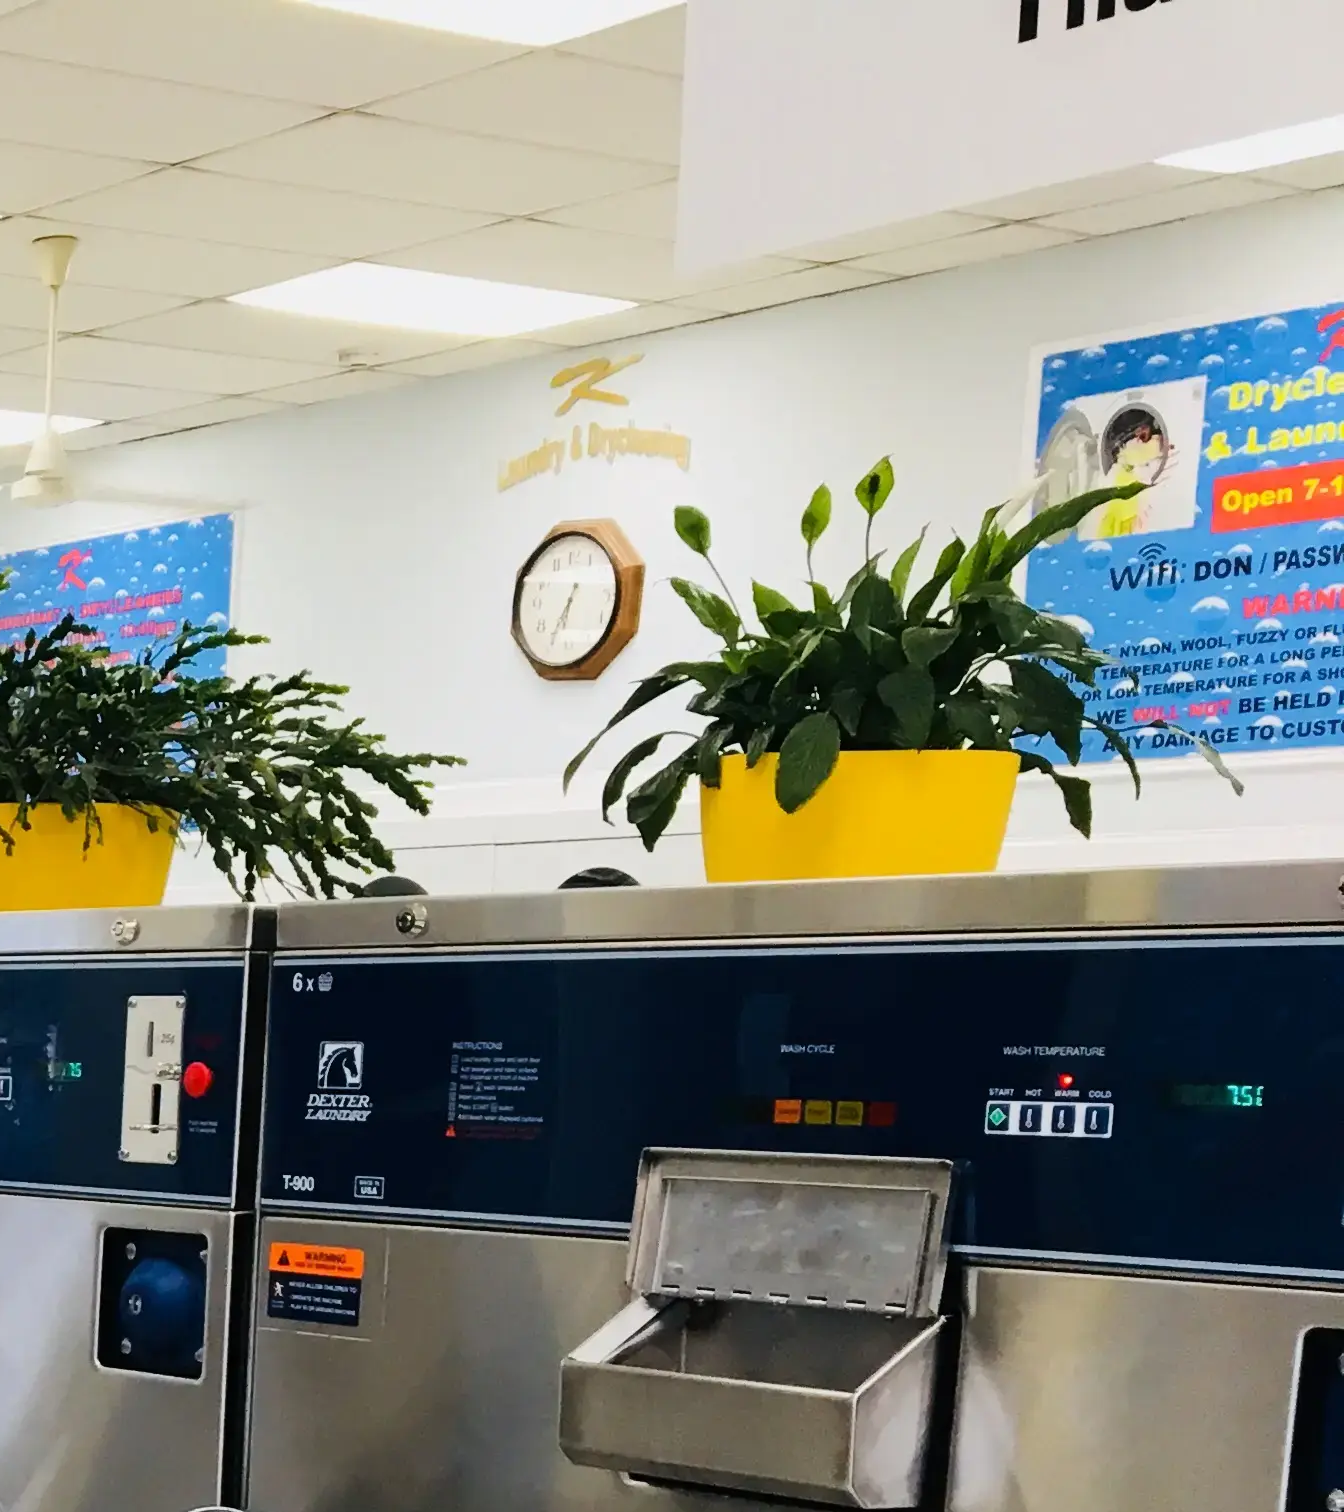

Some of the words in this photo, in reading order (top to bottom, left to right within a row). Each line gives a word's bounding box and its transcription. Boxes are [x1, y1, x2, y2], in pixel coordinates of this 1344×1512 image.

[1205, 431, 1232, 462] &
[1220, 486, 1293, 515] Open
[1109, 558, 1187, 592] Wifi:
[1194, 555, 1252, 582] DON
[1119, 641, 1177, 658] NYLON,
[1180, 636, 1232, 651] WOOL,
[1236, 629, 1290, 646] FUZZY
[1294, 626, 1318, 640] OR
[1100, 658, 1213, 680] TEMPERATURE
[1217, 655, 1249, 669] FOR
[1253, 654, 1265, 665] A
[1270, 648, 1316, 664] LONG
[1081, 689, 1102, 701] OR
[1144, 674, 1258, 696] TEMPERATURE
[1262, 672, 1296, 685] FOR
[1300, 670, 1313, 682] A
[1097, 708, 1127, 725] WE
[1133, 705, 1179, 723] WILL
[1188, 698, 1232, 718] NOT
[1238, 696, 1267, 714] BE
[1273, 691, 1332, 711] HELD
[1247, 724, 1275, 742] TO
[1281, 719, 1344, 739] CUST
[292, 972, 303, 992] 6
[306, 979, 314, 992] x
[780, 1044, 806, 1053] WASH
[807, 1044, 836, 1054] CYCLE
[1002, 1046, 1032, 1056] WASH
[1033, 1046, 1107, 1056] TEMPERATURE
[306, 1093, 370, 1108] DEXTER
[1088, 1090, 1112, 1099] COLD
[304, 1108, 372, 1122] LAUNDRY
[282, 1174, 315, 1192] T-900
